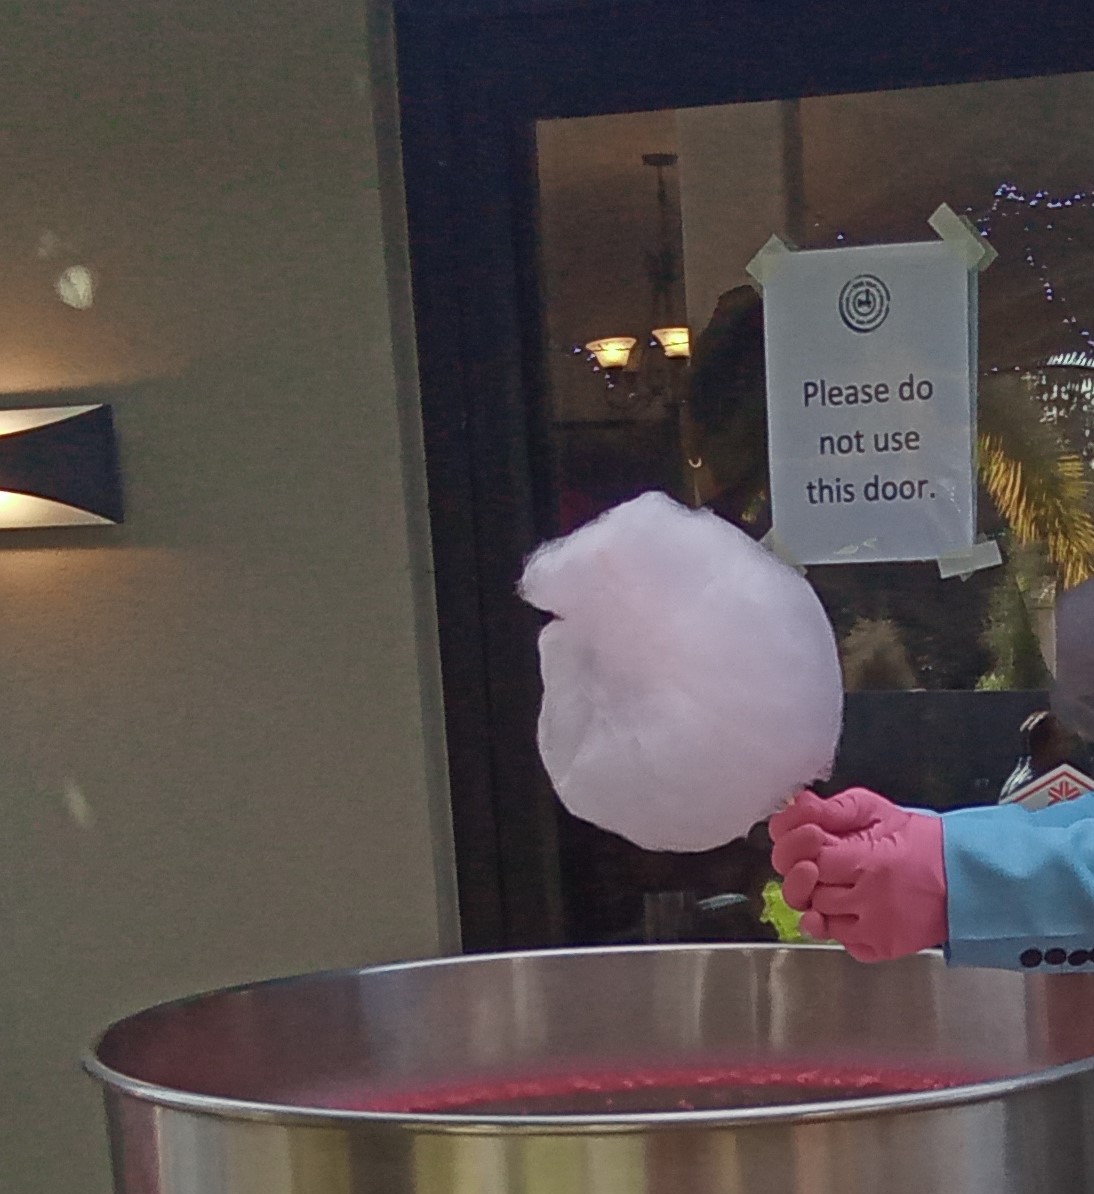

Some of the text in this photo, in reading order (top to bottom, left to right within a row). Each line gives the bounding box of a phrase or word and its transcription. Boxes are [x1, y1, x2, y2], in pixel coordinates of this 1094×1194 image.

[803, 373, 934, 407] Please do
[819, 429, 920, 455] not use
[806, 474, 936, 505] this door.
